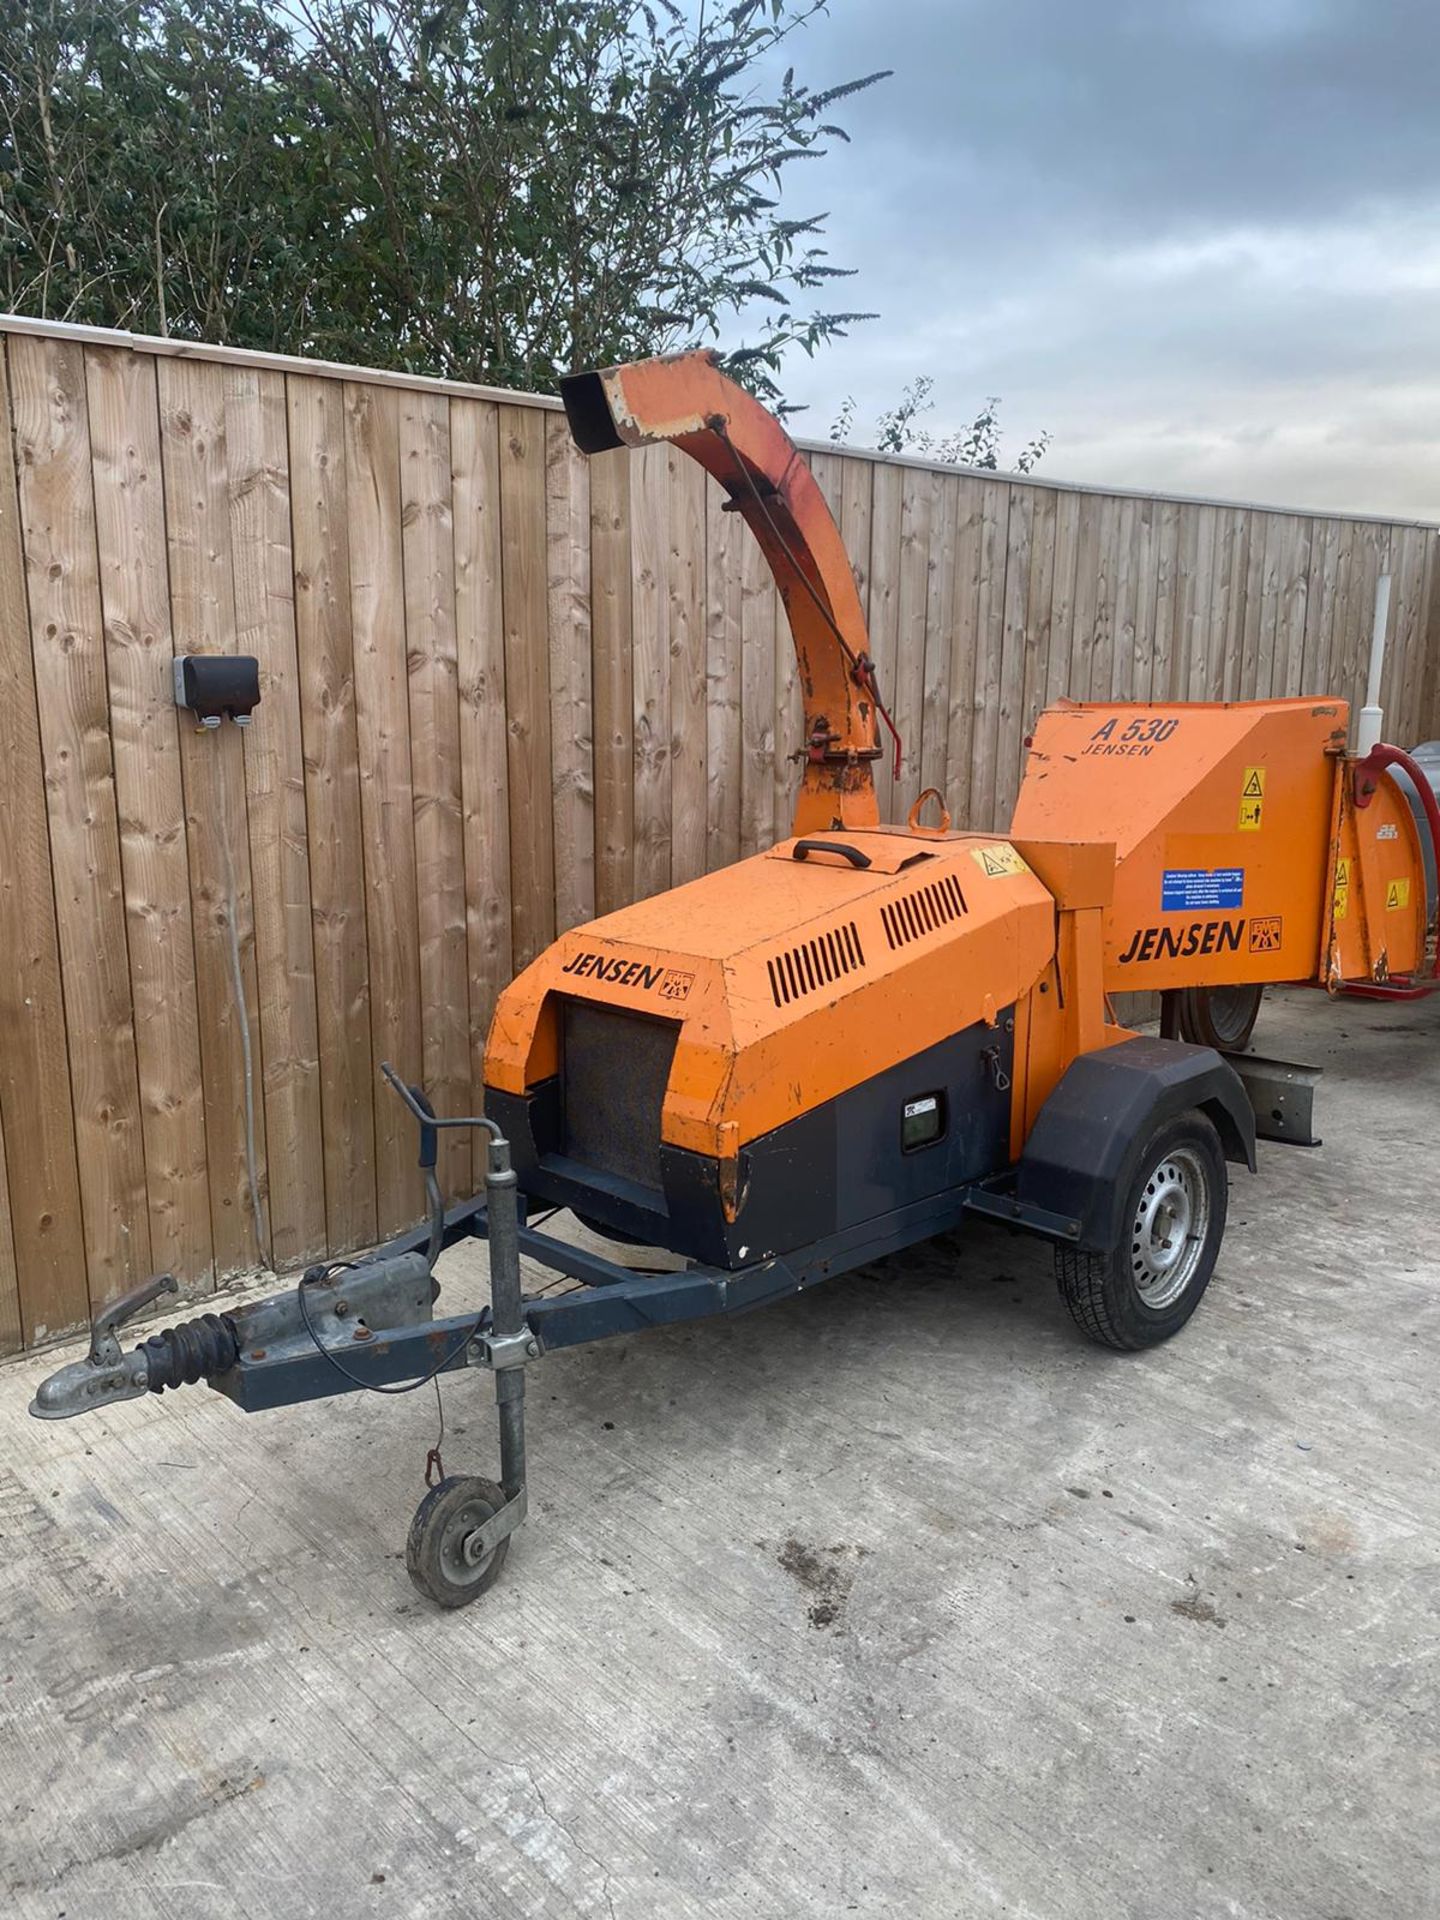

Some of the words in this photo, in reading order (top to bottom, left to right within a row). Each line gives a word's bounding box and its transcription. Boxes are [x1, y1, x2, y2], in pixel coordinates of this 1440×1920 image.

[1090, 718, 1119, 741] A
[1120, 718, 1179, 742] 530
[1081, 744, 1154, 756] JENSEN
[1118, 919, 1245, 963] JENSEN
[562, 952, 664, 989] JENSEN
